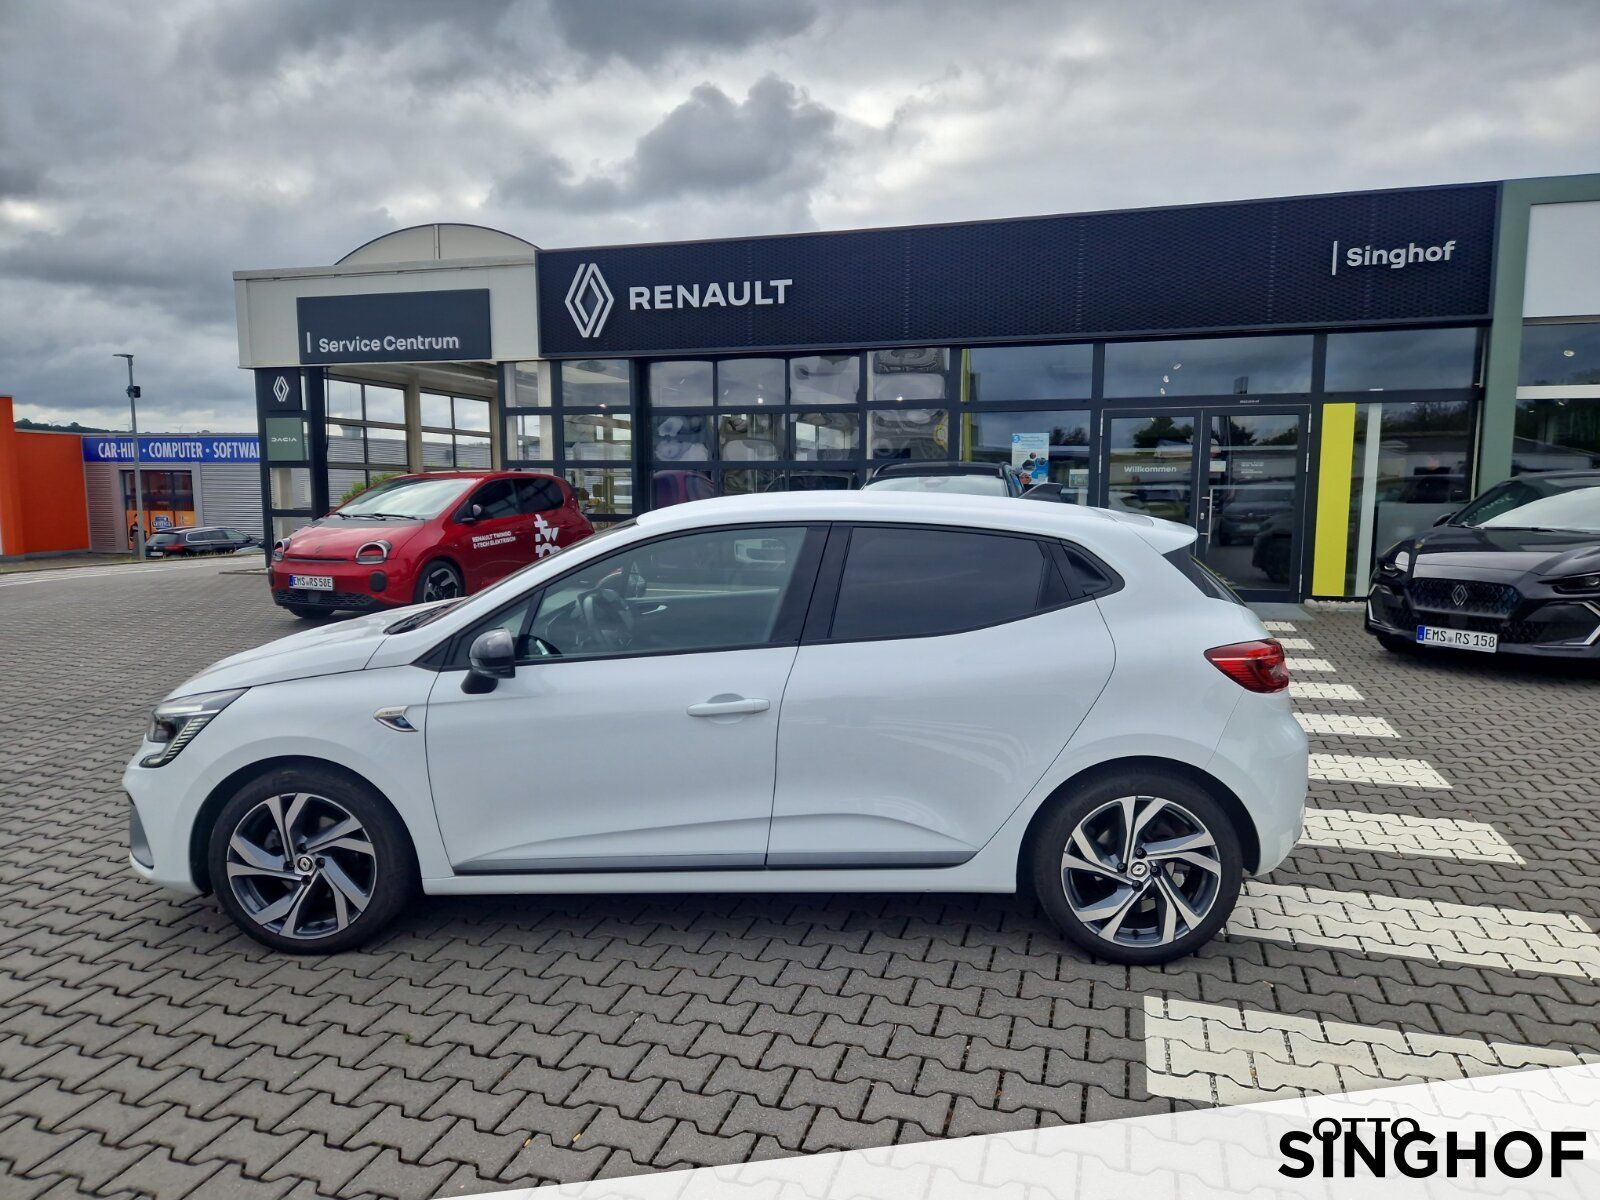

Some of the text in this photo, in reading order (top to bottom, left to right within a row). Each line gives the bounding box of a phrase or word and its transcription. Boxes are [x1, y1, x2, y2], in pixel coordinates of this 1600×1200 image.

[1346, 240, 1456, 269] Singhof
[629, 279, 793, 311] RENAULT
[318, 335, 459, 353] Service Centrum
[98, 442, 139, 458] CAR-HI
[149, 442, 203, 458] COMPUTER
[1123, 465, 1177, 473] Willkommen
[293, 576, 306, 586] EMS
[309, 577, 318, 587] RS
[1425, 628, 1496, 648] EMS RS 158
